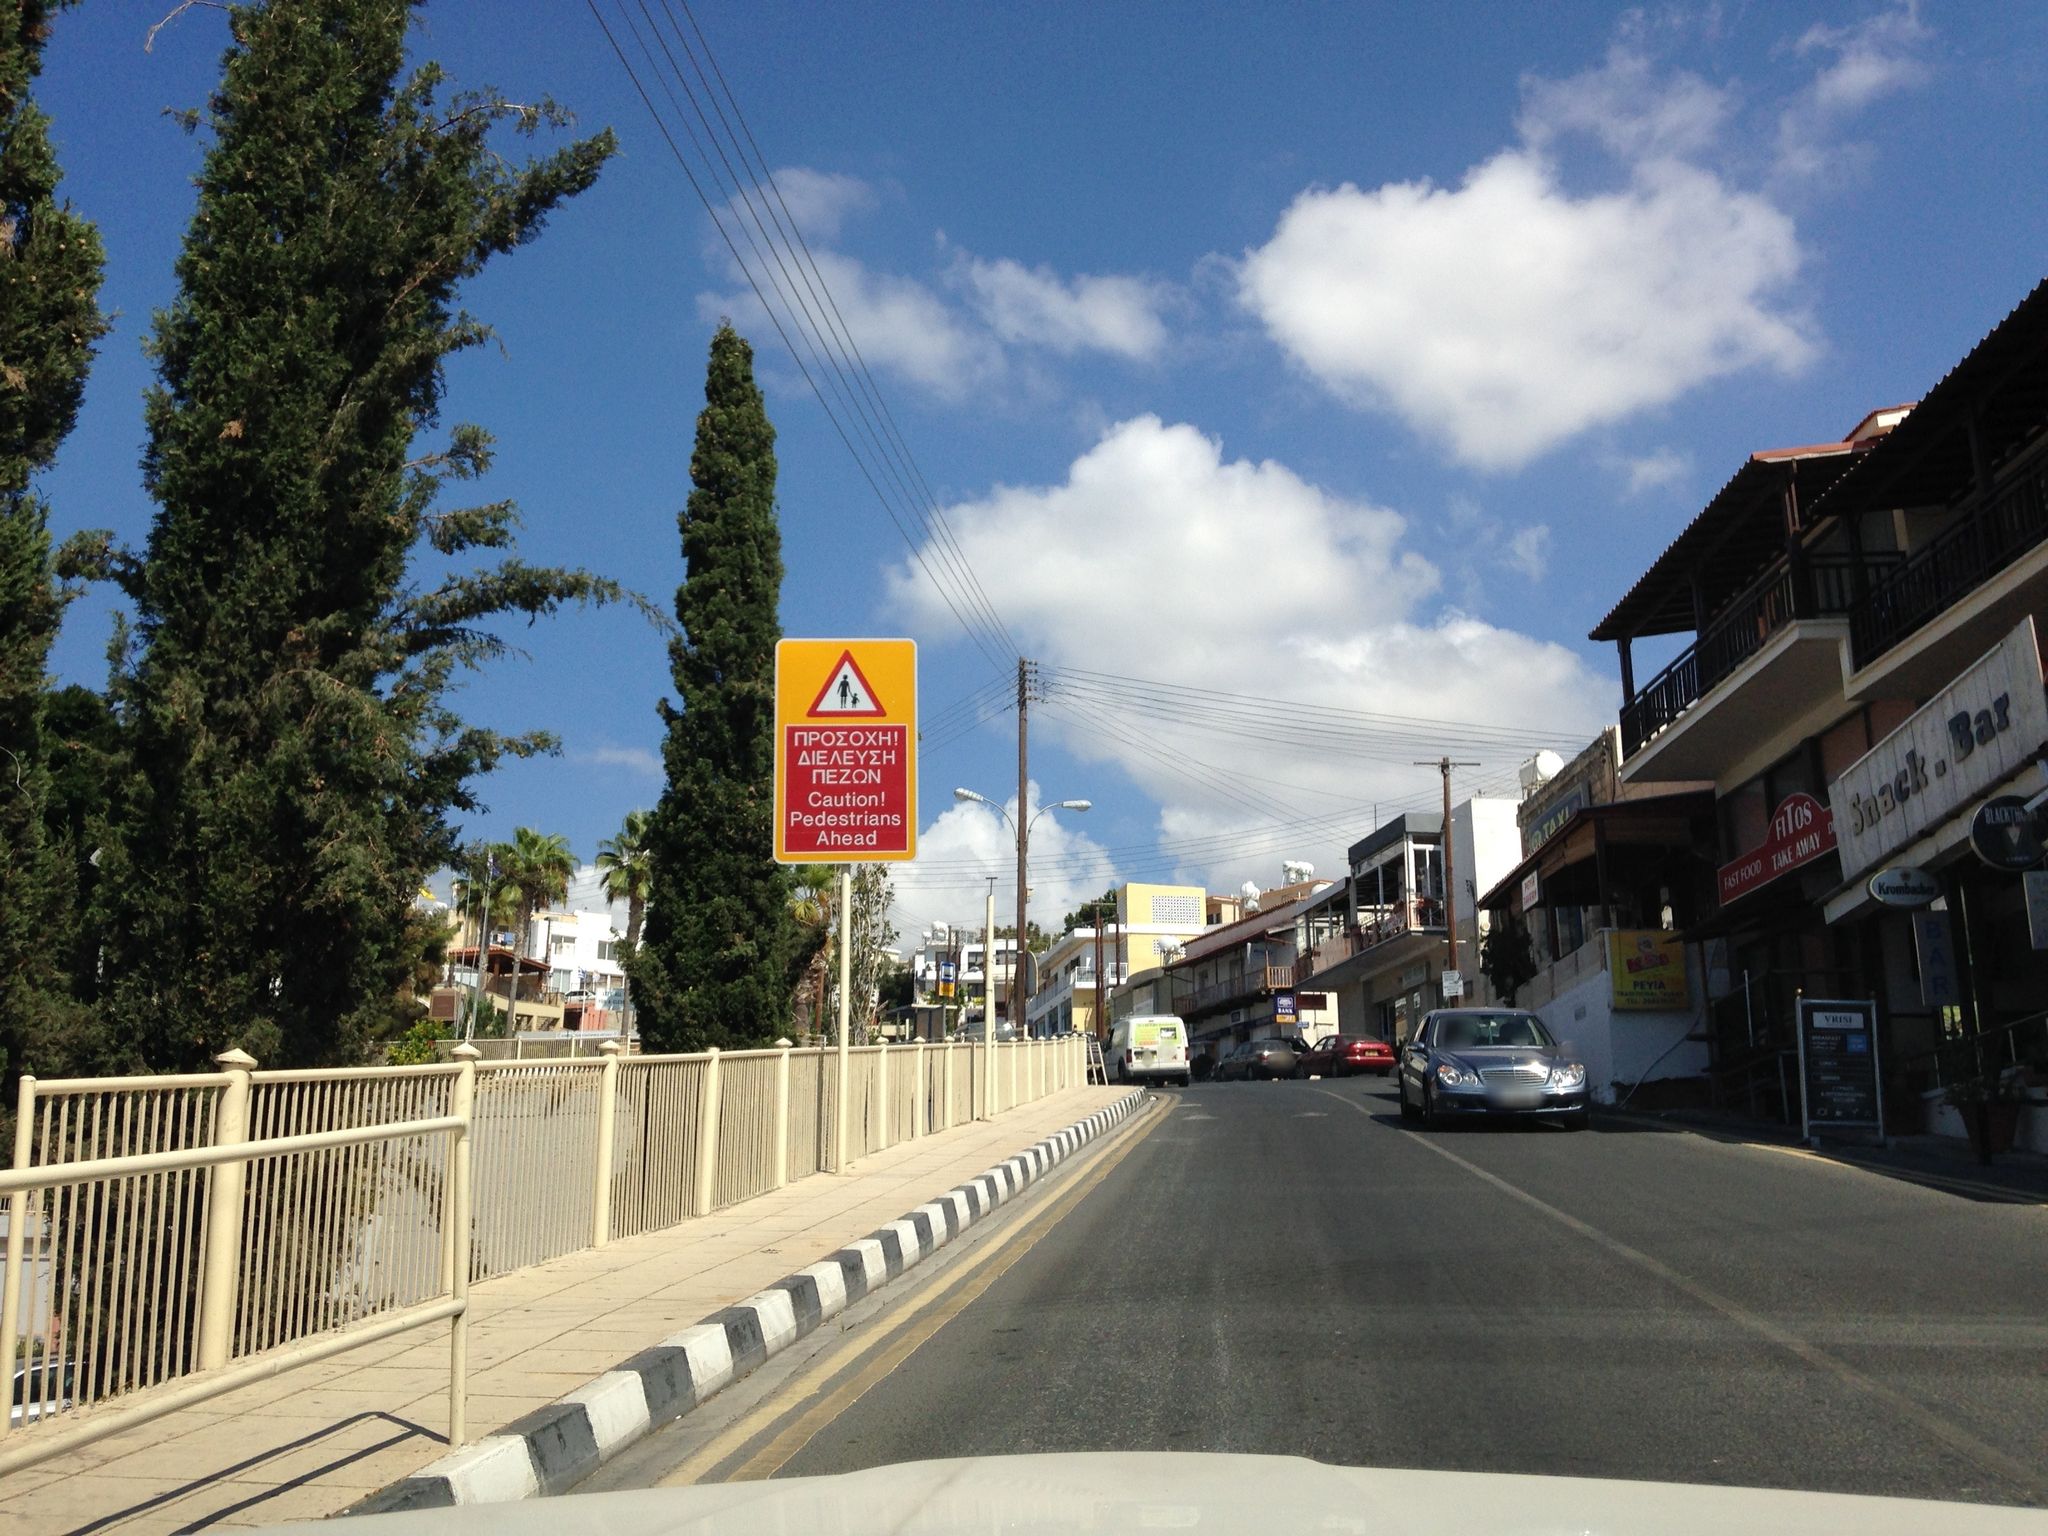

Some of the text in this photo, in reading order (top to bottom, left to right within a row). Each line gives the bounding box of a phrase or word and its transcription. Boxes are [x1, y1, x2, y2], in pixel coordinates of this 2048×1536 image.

[1948, 692, 2010, 763] Bar
[794, 731, 899, 747] ΠΡΟΣΟΧΗ!
[797, 750, 896, 766] ΔΙΕΛΕΥΣΗ
[812, 769, 881, 785] ΠΕΖΩΝ
[808, 791, 886, 807] Caution!
[790, 811, 901, 827] Pedestrians
[1542, 806, 1570, 840] TAXI
[816, 830, 877, 846] Ahead
[1723, 870, 1740, 891] FAST
[1740, 859, 1762, 883] FOOD
[1771, 845, 1794, 872] TAKE
[1795, 830, 1821, 860] AWAY
[1878, 882, 1935, 895] Krombacher
[1925, 920, 1949, 995] BAR
[1632, 980, 1666, 991] PEYIA
[1824, 1015, 1853, 1024] VRISI
